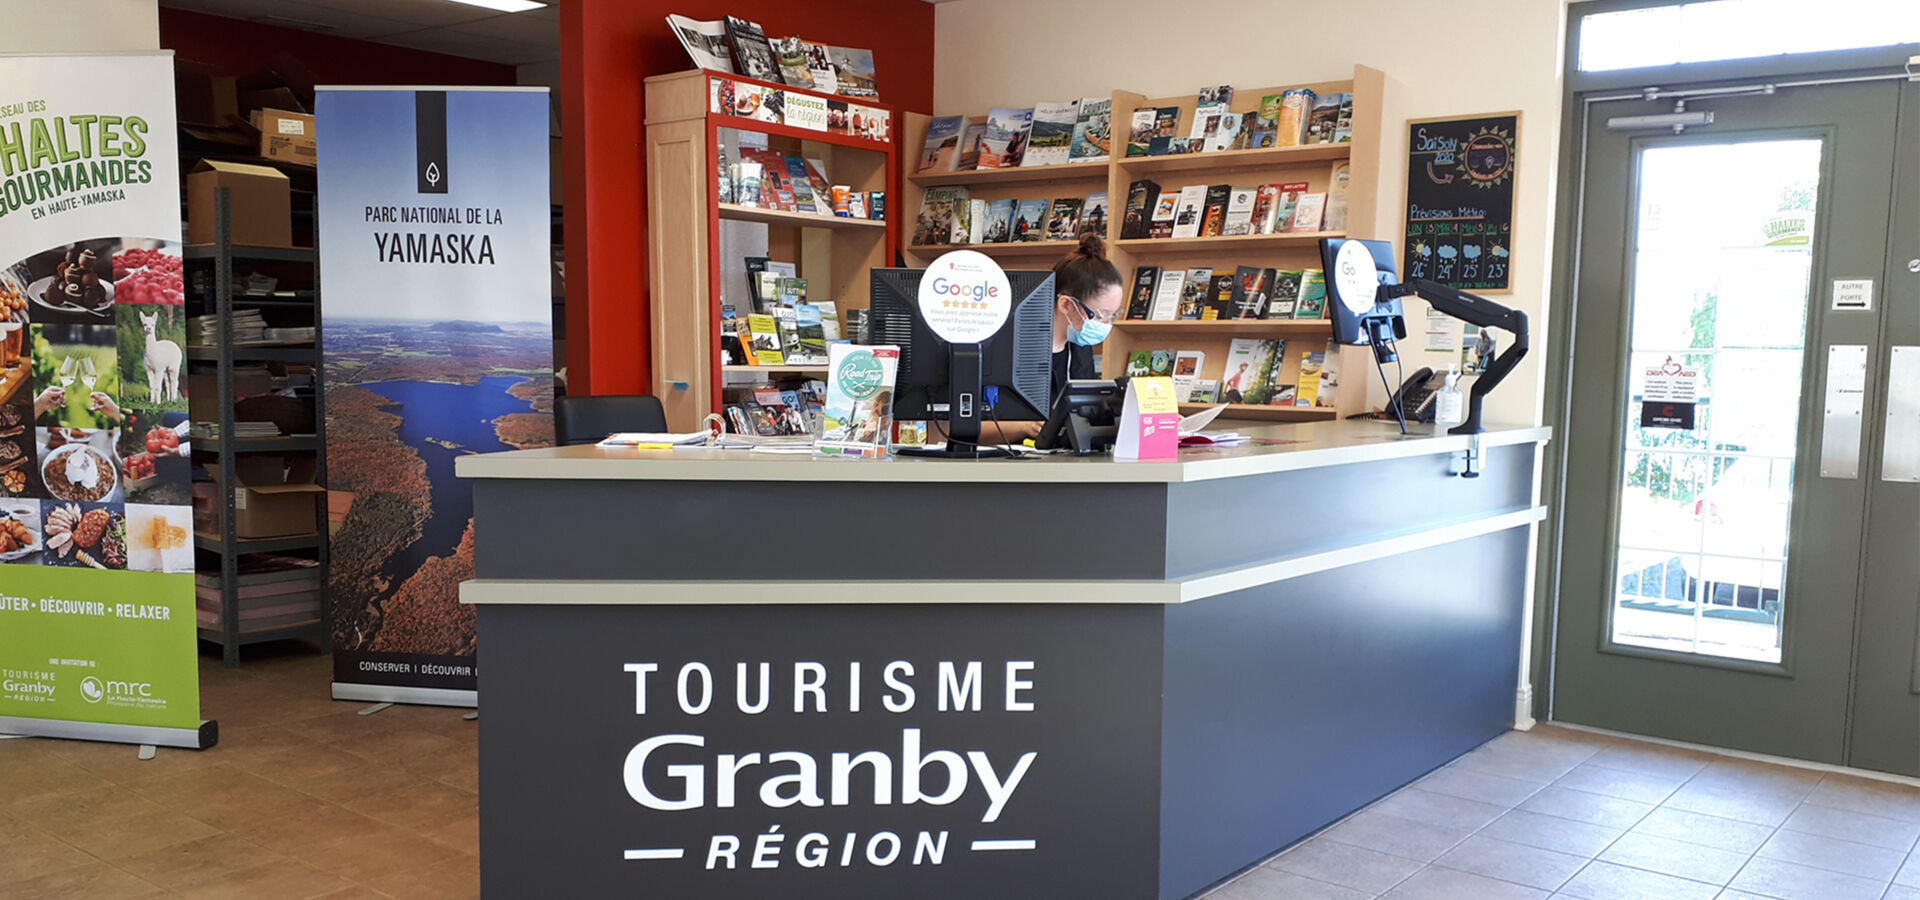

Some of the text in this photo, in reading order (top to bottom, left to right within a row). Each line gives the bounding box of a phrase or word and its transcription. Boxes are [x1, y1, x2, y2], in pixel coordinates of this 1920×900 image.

[0, 99, 46, 119] SEAU DES
[786, 95, 825, 111] DÉGUSTEZ
[797, 109, 826, 127] région
[0, 113, 149, 177] HALTES
[1434, 152, 1455, 163] 2020
[31, 188, 126, 220] EN HAUTE-YAMASKA
[365, 206, 503, 225] PARC NATIONAL DE LA
[374, 231, 495, 266] YAMASKA
[933, 277, 999, 302] Google
[840, 362, 865, 380] Road
[40, 595, 105, 616] DÉCOUVRIR
[116, 602, 171, 620] RELAXER
[2, 668, 56, 681] TOURISME
[359, 660, 471, 677] CONSERVER DÉCOUVRIR
[2, 679, 56, 697] Granby
[107, 680, 152, 697] mrc
[622, 659, 1036, 716] TOURISME
[14, 694, 46, 703] RÉGION
[622, 727, 1039, 824] Granby
[704, 823, 950, 870] RÉGION
